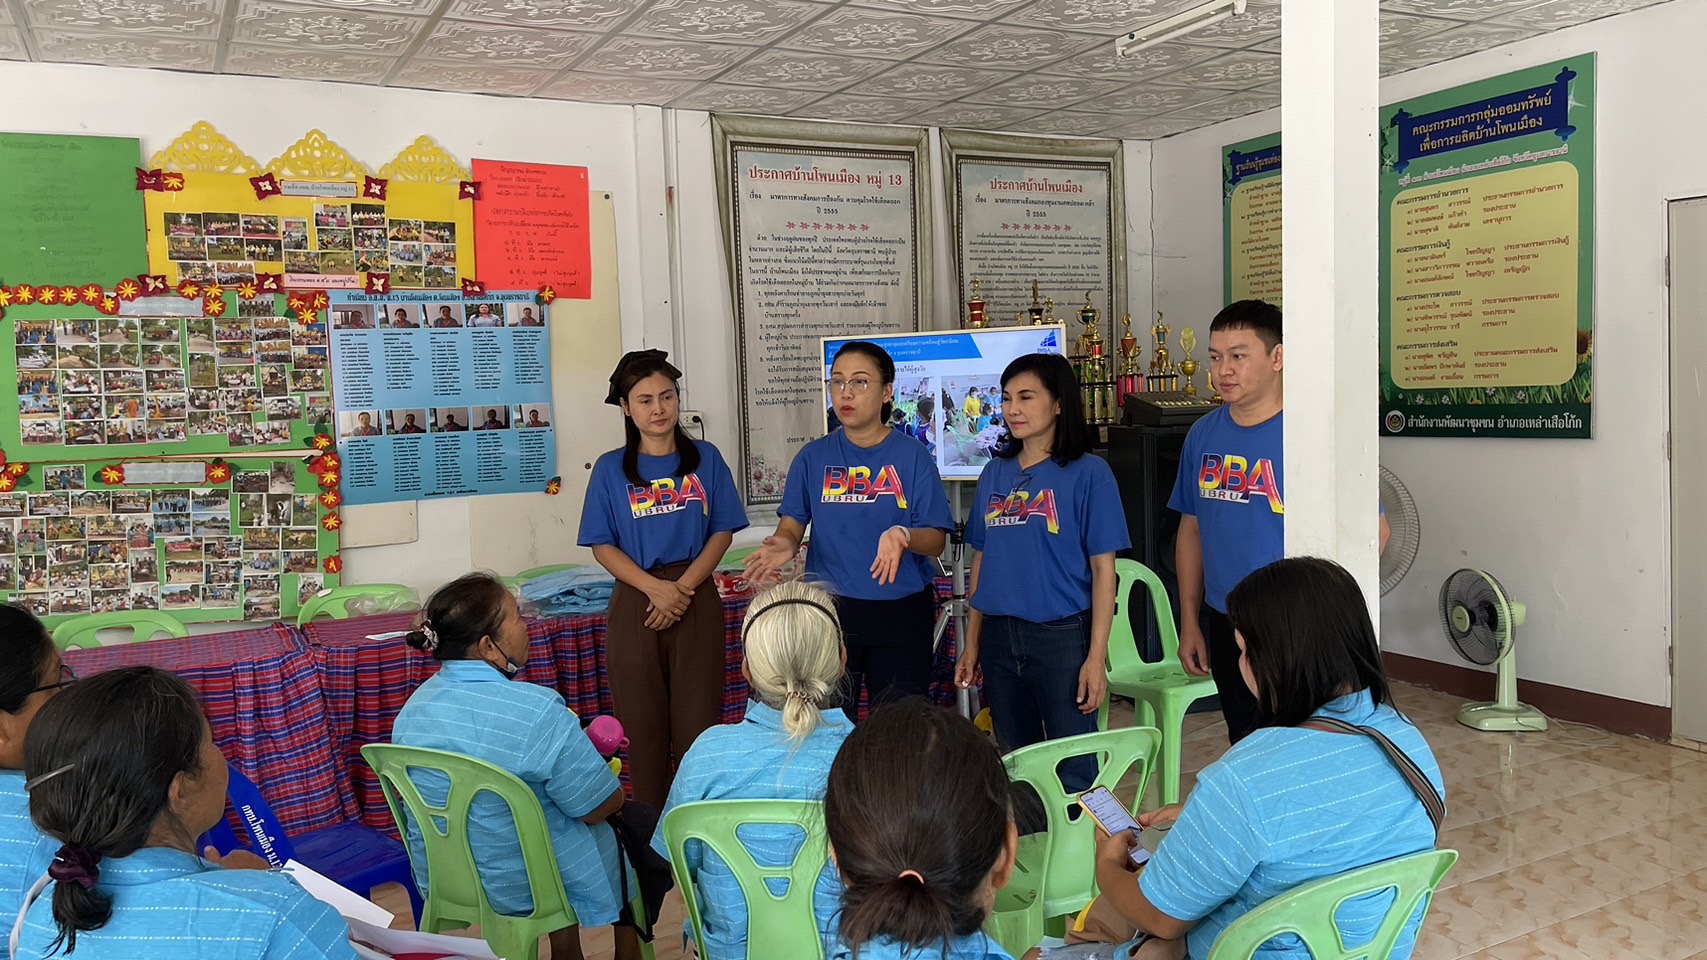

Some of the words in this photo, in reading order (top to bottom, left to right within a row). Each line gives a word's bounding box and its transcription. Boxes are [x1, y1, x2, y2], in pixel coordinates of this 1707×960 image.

[1412, 89, 1552, 136] คณะกรรมการกลุ่มออมทรัพย์
[1420, 114, 1543, 151] เพื่อการผลิตบ้านโพนเมือง
[748, 165, 861, 185] ประกาศบ้านโพนเมือง
[866, 170, 882, 190] หมู่
[889, 174, 903, 186] 13
[990, 177, 1083, 193] ประกาศบ้านโพนเมือง
[749, 191, 762, 200] เรื่อง
[975, 193, 987, 204] เรื่อง
[816, 206, 822, 214] ปี
[1026, 209, 1031, 218] ปี
[1481, 320, 1508, 328] กรรมการ
[1474, 372, 1499, 380] กรรมการ
[1407, 414, 1495, 433] สำนักงานพัฒนาชุมชน
[1497, 412, 1582, 429] อำเภอเหล่าเสือโก้ก
[822, 464, 907, 509] BBA
[1199, 453, 1284, 515] BBA
[625, 473, 709, 517] BBA
[633, 505, 676, 518] UBRU
[985, 489, 1059, 535] BBA
